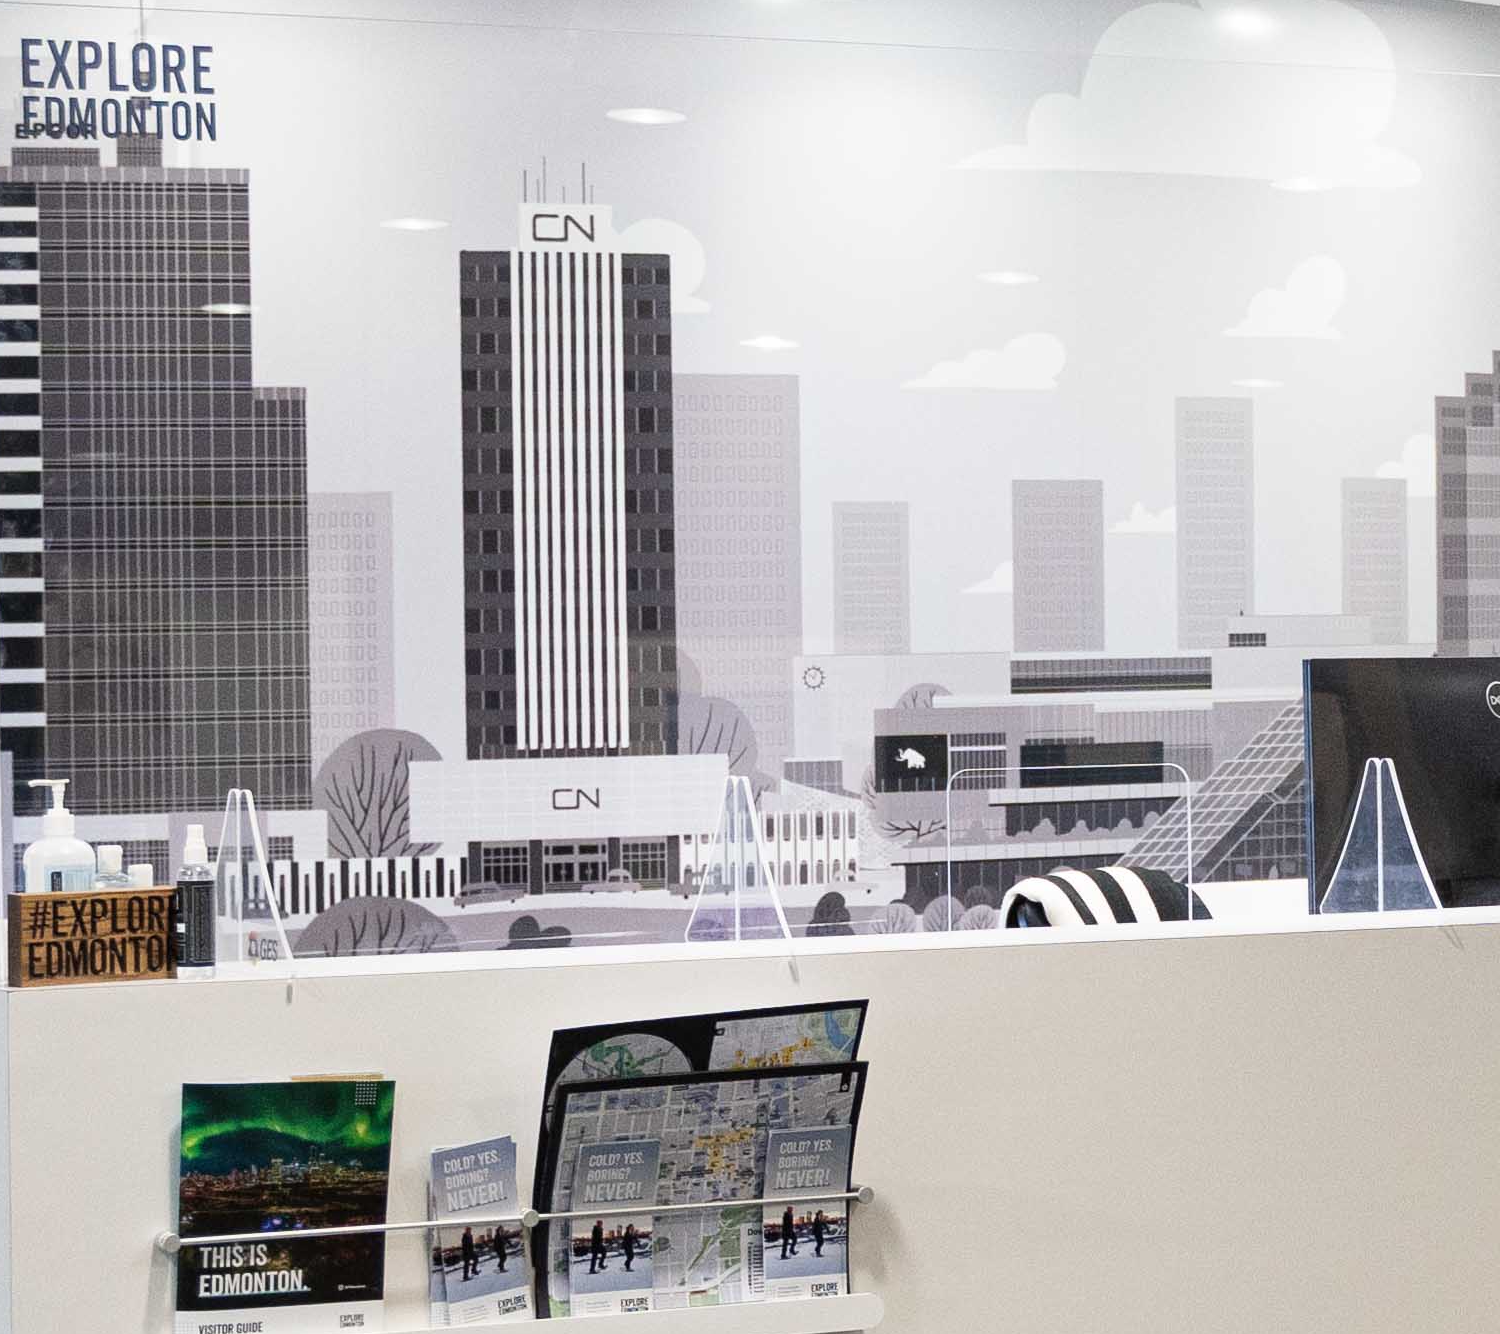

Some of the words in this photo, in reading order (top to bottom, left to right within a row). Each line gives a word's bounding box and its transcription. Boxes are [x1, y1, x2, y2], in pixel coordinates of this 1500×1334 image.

[20, 38, 216, 95] EXPLORE
[22, 96, 218, 142] EDMONTON
[15, 122, 98, 141] EPCOR
[532, 213, 595, 243] CN
[552, 787, 600, 810] CN
[780, 1140, 812, 1155] COLD?
[443, 1154, 476, 1174] COLD?
[589, 1153, 621, 1167] COLD?
[445, 1167, 490, 1189] BORING?
[774, 1167, 832, 1190] NEVER!
[447, 1180, 507, 1212] NEVER!
[583, 1181, 644, 1203] NEVER!
[200, 1244, 244, 1269] THIS
[249, 1243, 269, 1267] IS
[199, 1270, 311, 1297] EDMONTON.
[236, 1321, 264, 1334] GUIDE
